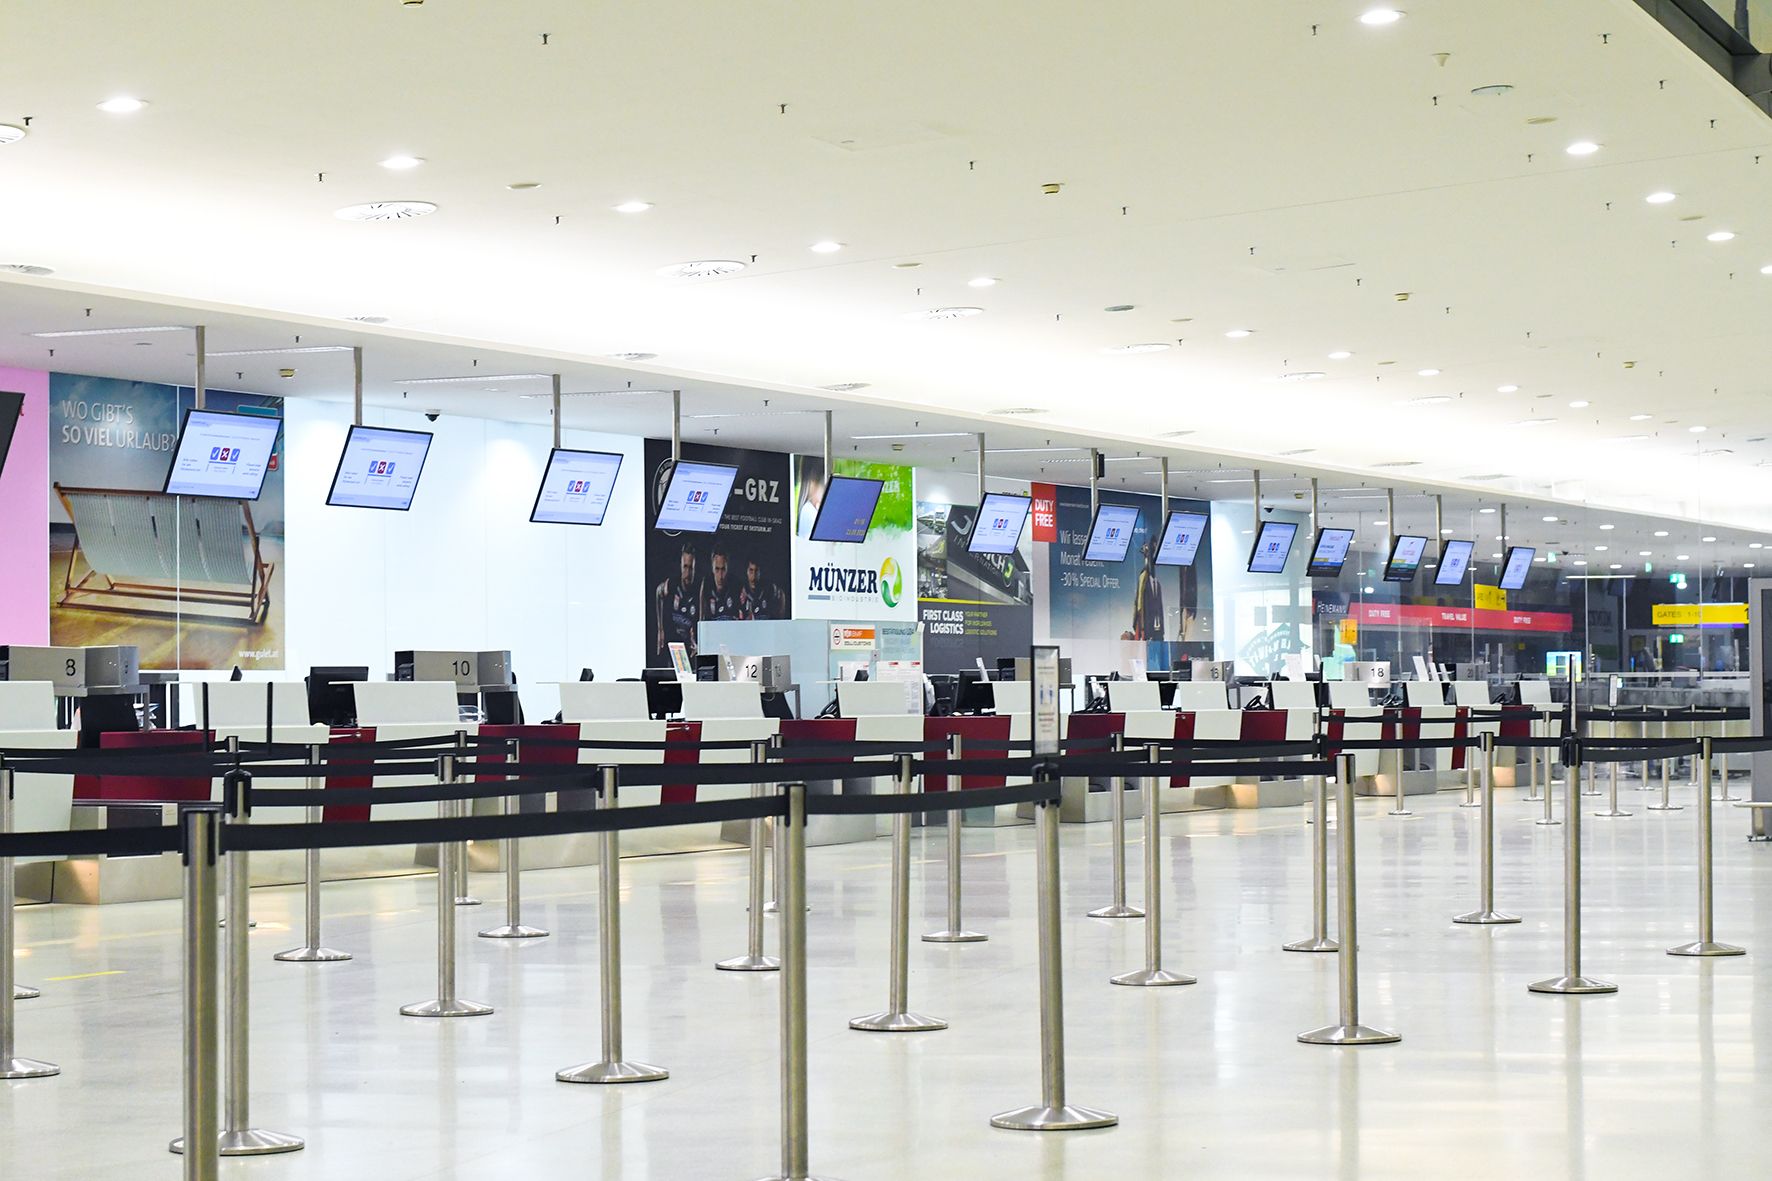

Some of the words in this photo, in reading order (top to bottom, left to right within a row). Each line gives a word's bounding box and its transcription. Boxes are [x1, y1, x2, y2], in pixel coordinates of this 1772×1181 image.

[62, 400, 87, 420] WO
[90, 402, 134, 425] GIBT'S
[62, 425, 81, 444] SO
[84, 426, 113, 447] VIEL
[115, 430, 176, 452] URLAUB?
[734, 477, 780, 503] -GRZ
[1035, 499, 1054, 512] DUTY
[1035, 513, 1054, 527] FREE
[1060, 530, 1071, 544] Wir
[1072, 530, 1088, 545] lasse
[1060, 551, 1081, 566] Monat
[809, 562, 878, 594] MÜNZER
[923, 609, 942, 621] FIRST
[942, 610, 964, 622] CLASS
[930, 622, 964, 635] LOGISTICS
[65, 658, 76, 677] 8
[452, 660, 471, 676] 10
[745, 664, 758, 678] 12
[1371, 666, 1385, 678] 18
